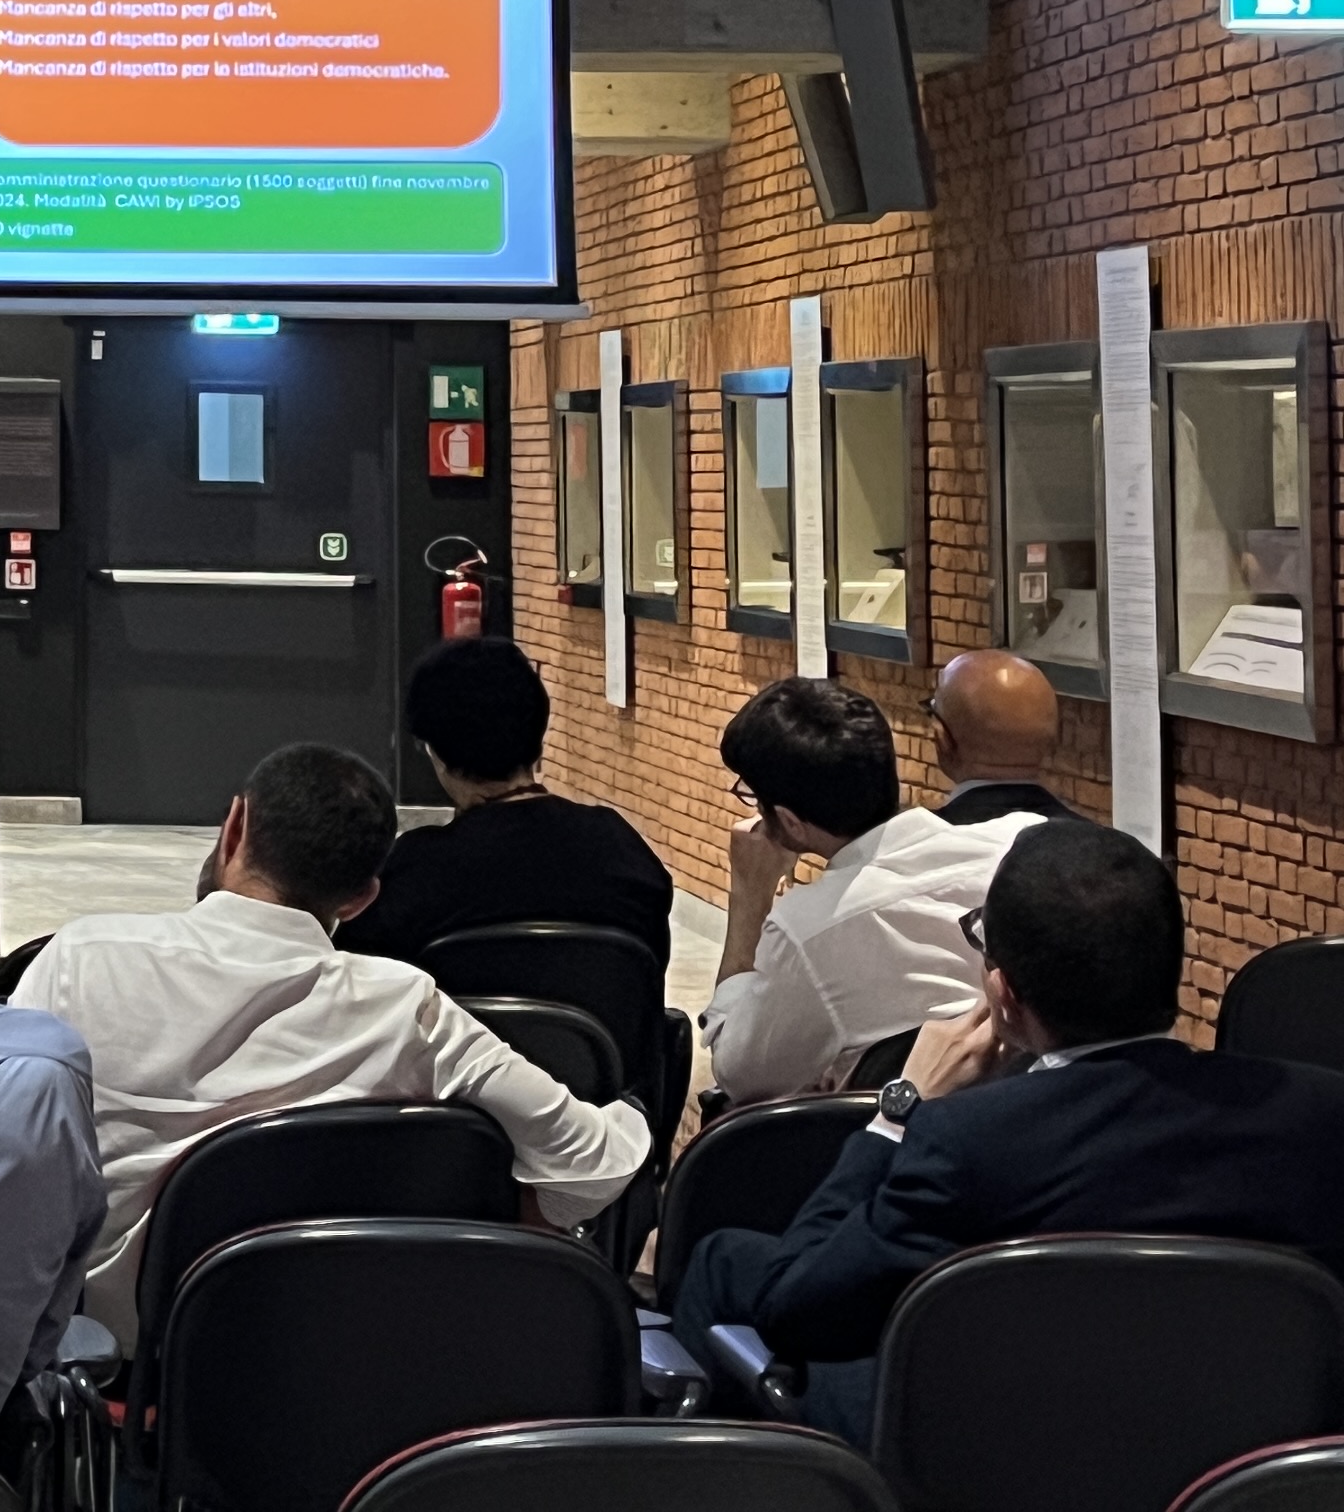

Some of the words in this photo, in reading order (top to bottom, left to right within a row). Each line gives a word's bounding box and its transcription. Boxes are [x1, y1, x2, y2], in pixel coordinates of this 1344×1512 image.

[90, 1, 106, 16] di
[110, 1, 177, 19] rispetto
[181, 3, 210, 19] per
[213, 2, 234, 20] gli
[238, 1, 277, 19] altri,
[90, 30, 106, 46] di
[110, 31, 177, 49] rispetto
[181, 33, 210, 49] per
[222, 32, 271, 47] valori
[274, 33, 380, 48] democratici
[90, 60, 106, 76] di
[110, 60, 177, 79] rispetto
[181, 63, 210, 79] per
[214, 61, 230, 76] le
[234, 62, 318, 78] istituzioni
[322, 62, 450, 78] democratiche.
[137, 173, 242, 190] questionario
[246, 174, 293, 190] (1500
[297, 174, 367, 191] soggetti)
[372, 175, 402, 189] fine
[407, 176, 489, 189] novembre
[34, 193, 107, 208] Modalità
[115, 195, 160, 208] CAWI
[165, 195, 184, 211] by
[189, 195, 241, 209] IPSOS
[8, 222, 74, 239] vignette
